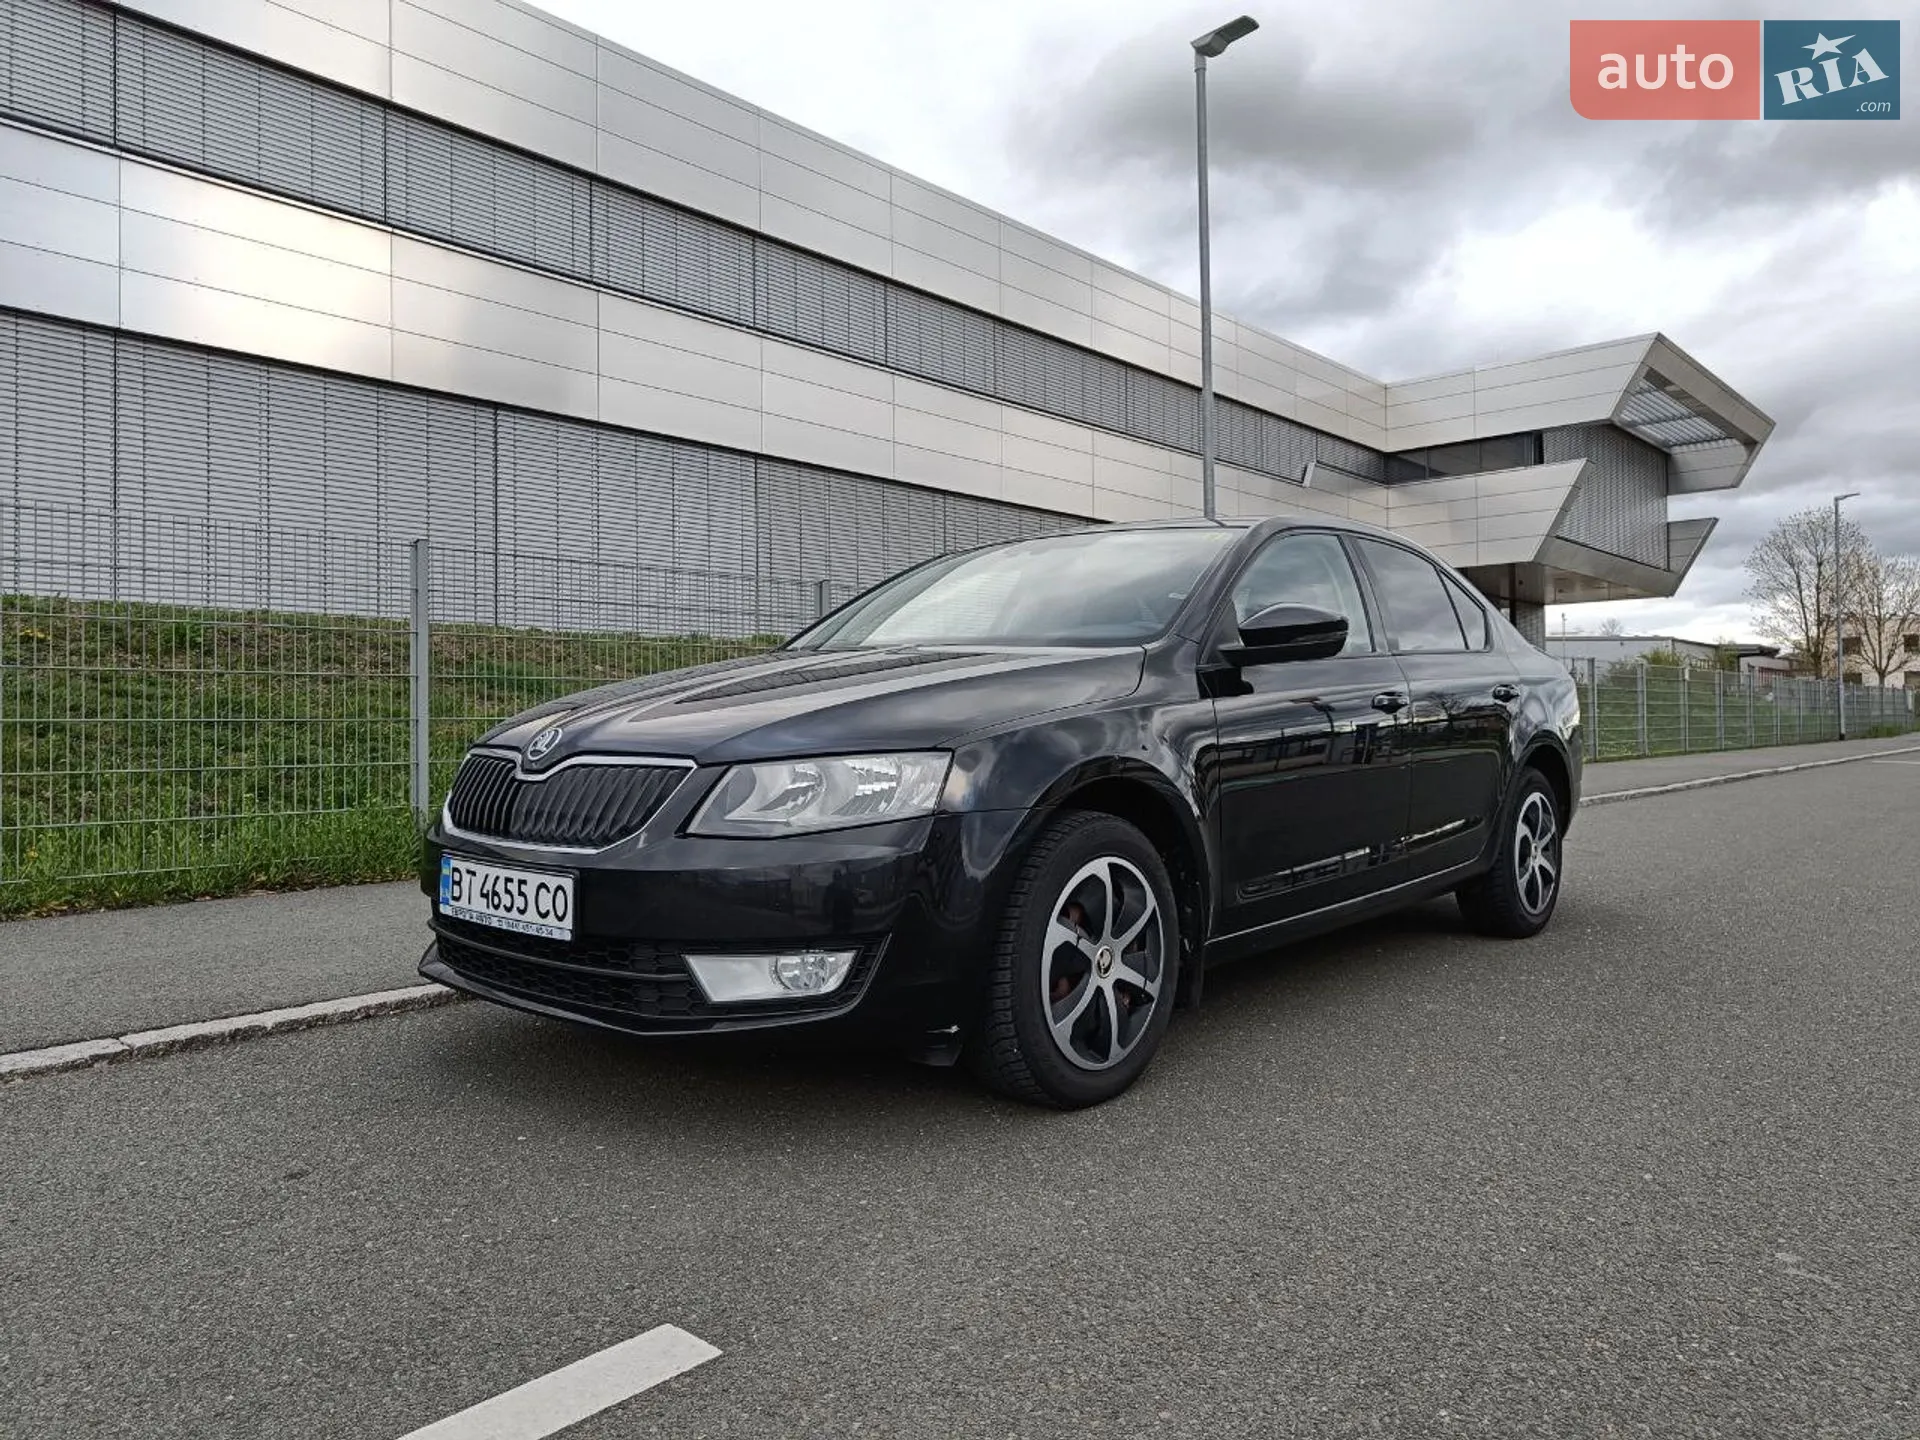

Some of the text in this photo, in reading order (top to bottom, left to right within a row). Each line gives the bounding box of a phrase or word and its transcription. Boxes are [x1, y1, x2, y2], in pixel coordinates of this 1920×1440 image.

[452, 867, 568, 922] BT 4655 CO
